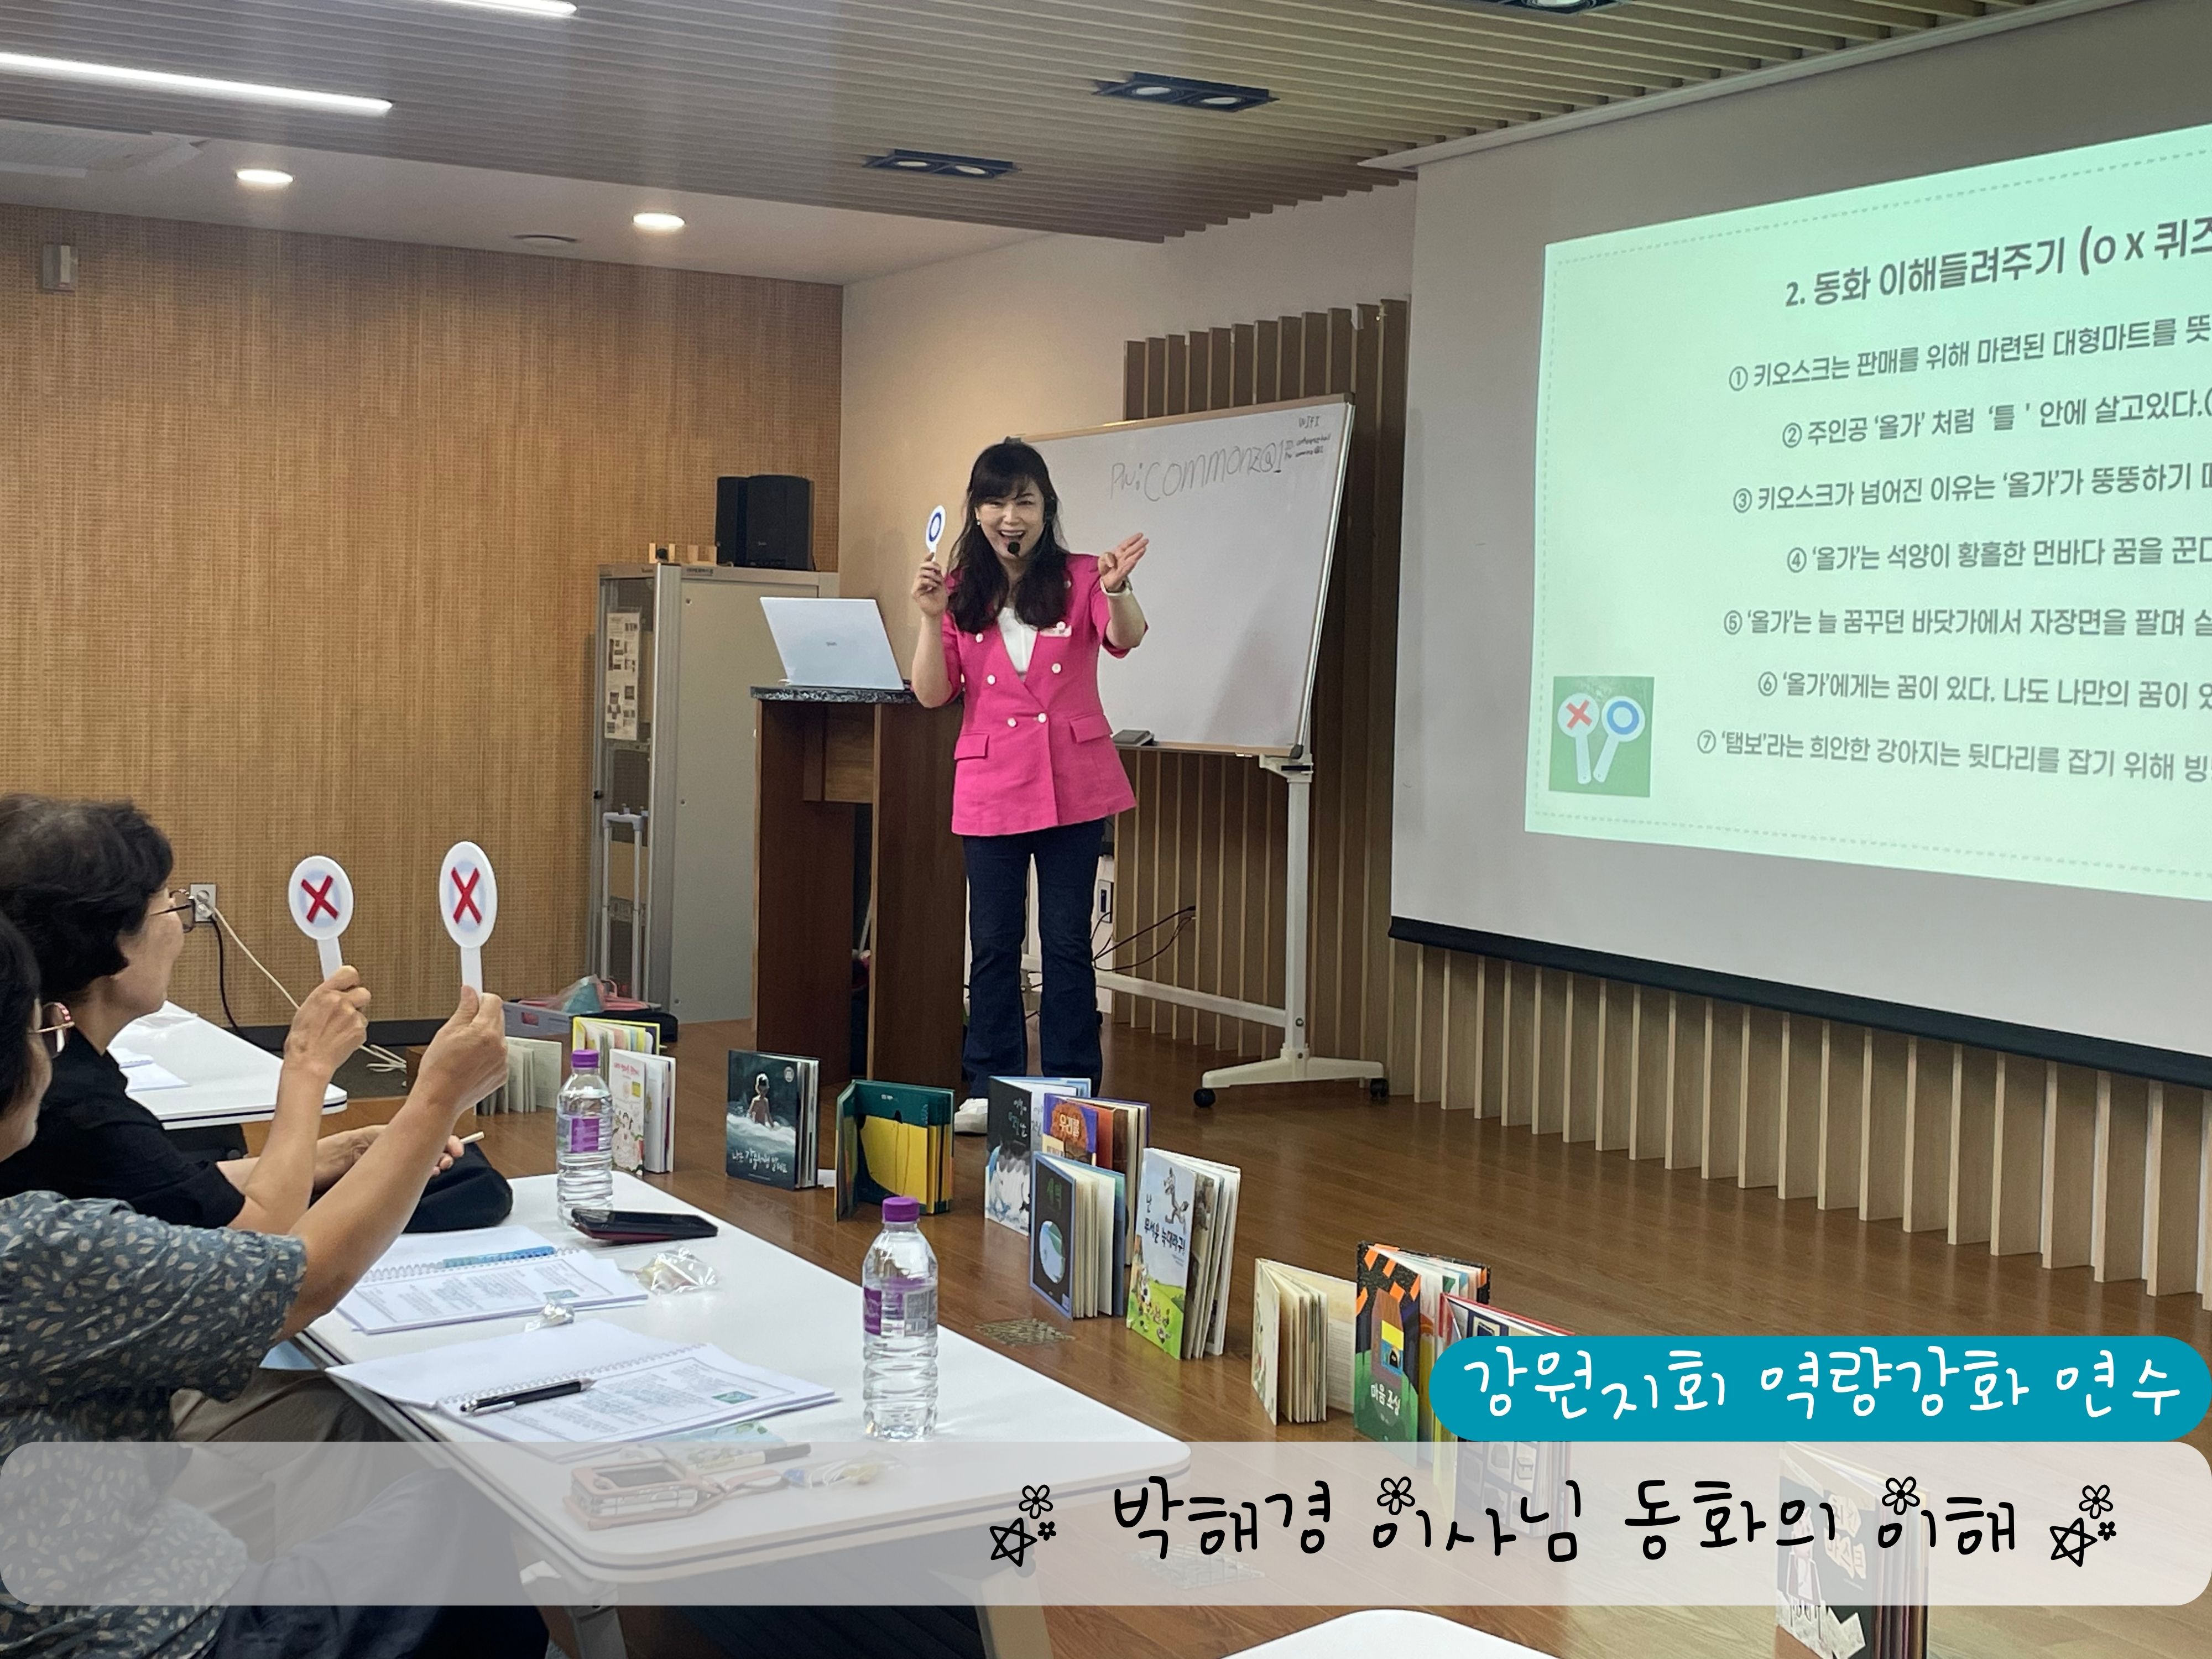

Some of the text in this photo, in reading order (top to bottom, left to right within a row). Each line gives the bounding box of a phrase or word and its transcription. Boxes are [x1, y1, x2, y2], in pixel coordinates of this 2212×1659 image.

[1785, 281, 1806, 307] 2.
[1813, 265, 1871, 306] 동화
[1880, 236, 2065, 296] 이해들려주기
[1754, 355, 1851, 387] 키오스크는
[1857, 347, 1919, 377] 판매를
[1926, 340, 1970, 371] 위해
[1977, 332, 2045, 364] 마련된
[2053, 318, 2177, 356] 대형마트를
[1807, 417, 1868, 446] 주인공
[1931, 407, 1975, 435] 처럼
[2039, 398, 2087, 428] 안에
[1757, 481, 1855, 511] 키오스크가
[1861, 477, 1923, 505] 넘어진
[1931, 474, 1996, 502] 이유는
[2091, 462, 2192, 495] 뚱뚱하기
[1887, 542, 1950, 570] 석양이
[1958, 540, 2027, 568] 황홀한
[2033, 538, 2106, 567] 먼바다
[2113, 536, 2163, 565] 꿈을
[1818, 609, 1837, 634] 늘
[1844, 609, 1905, 635] 꿈꾸던
[1912, 608, 2022, 635] 바닷가에서
[2029, 608, 2127, 636] 자장면을
[2135, 608, 2185, 637] 팔며
[1897, 675, 1939, 701] 꿈이
[1946, 676, 1996, 703] 있다.
[2004, 677, 2049, 703] 나도
[2057, 679, 2129, 708] 나만의
[2138, 681, 2188, 710] 꿈이
[1809, 734, 1871, 762] 희안한
[1877, 738, 1961, 768] 강아지는
[1968, 743, 2060, 774] 뒷다리를
[2068, 748, 2115, 778] 잡기
[2123, 752, 2174, 781] 위해
